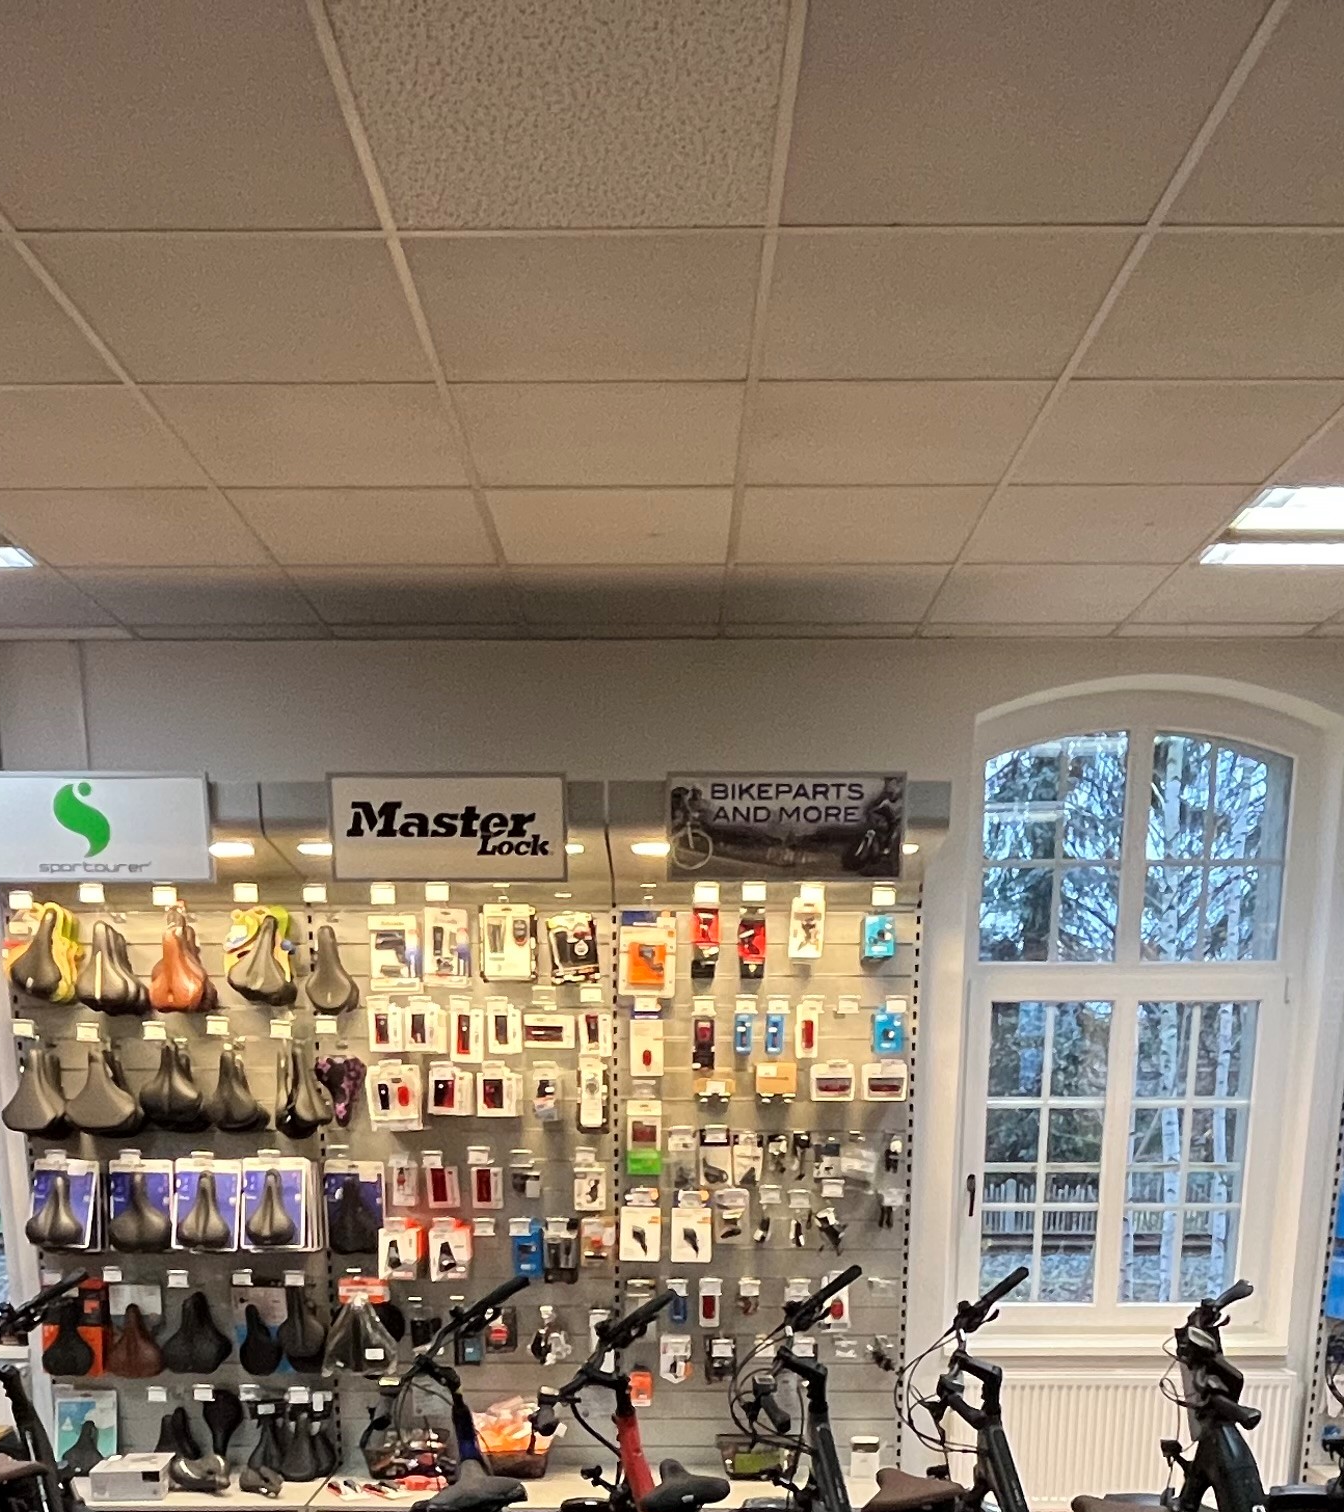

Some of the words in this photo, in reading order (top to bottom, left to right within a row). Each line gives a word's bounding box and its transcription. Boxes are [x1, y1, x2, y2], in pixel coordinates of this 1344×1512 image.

[711, 783, 865, 801] BIKEPARTS
[346, 801, 536, 837] Master
[713, 806, 771, 823] AND
[779, 806, 862, 823] MORE
[477, 834, 550, 856] Lock
[38, 860, 152, 874] sportourer
